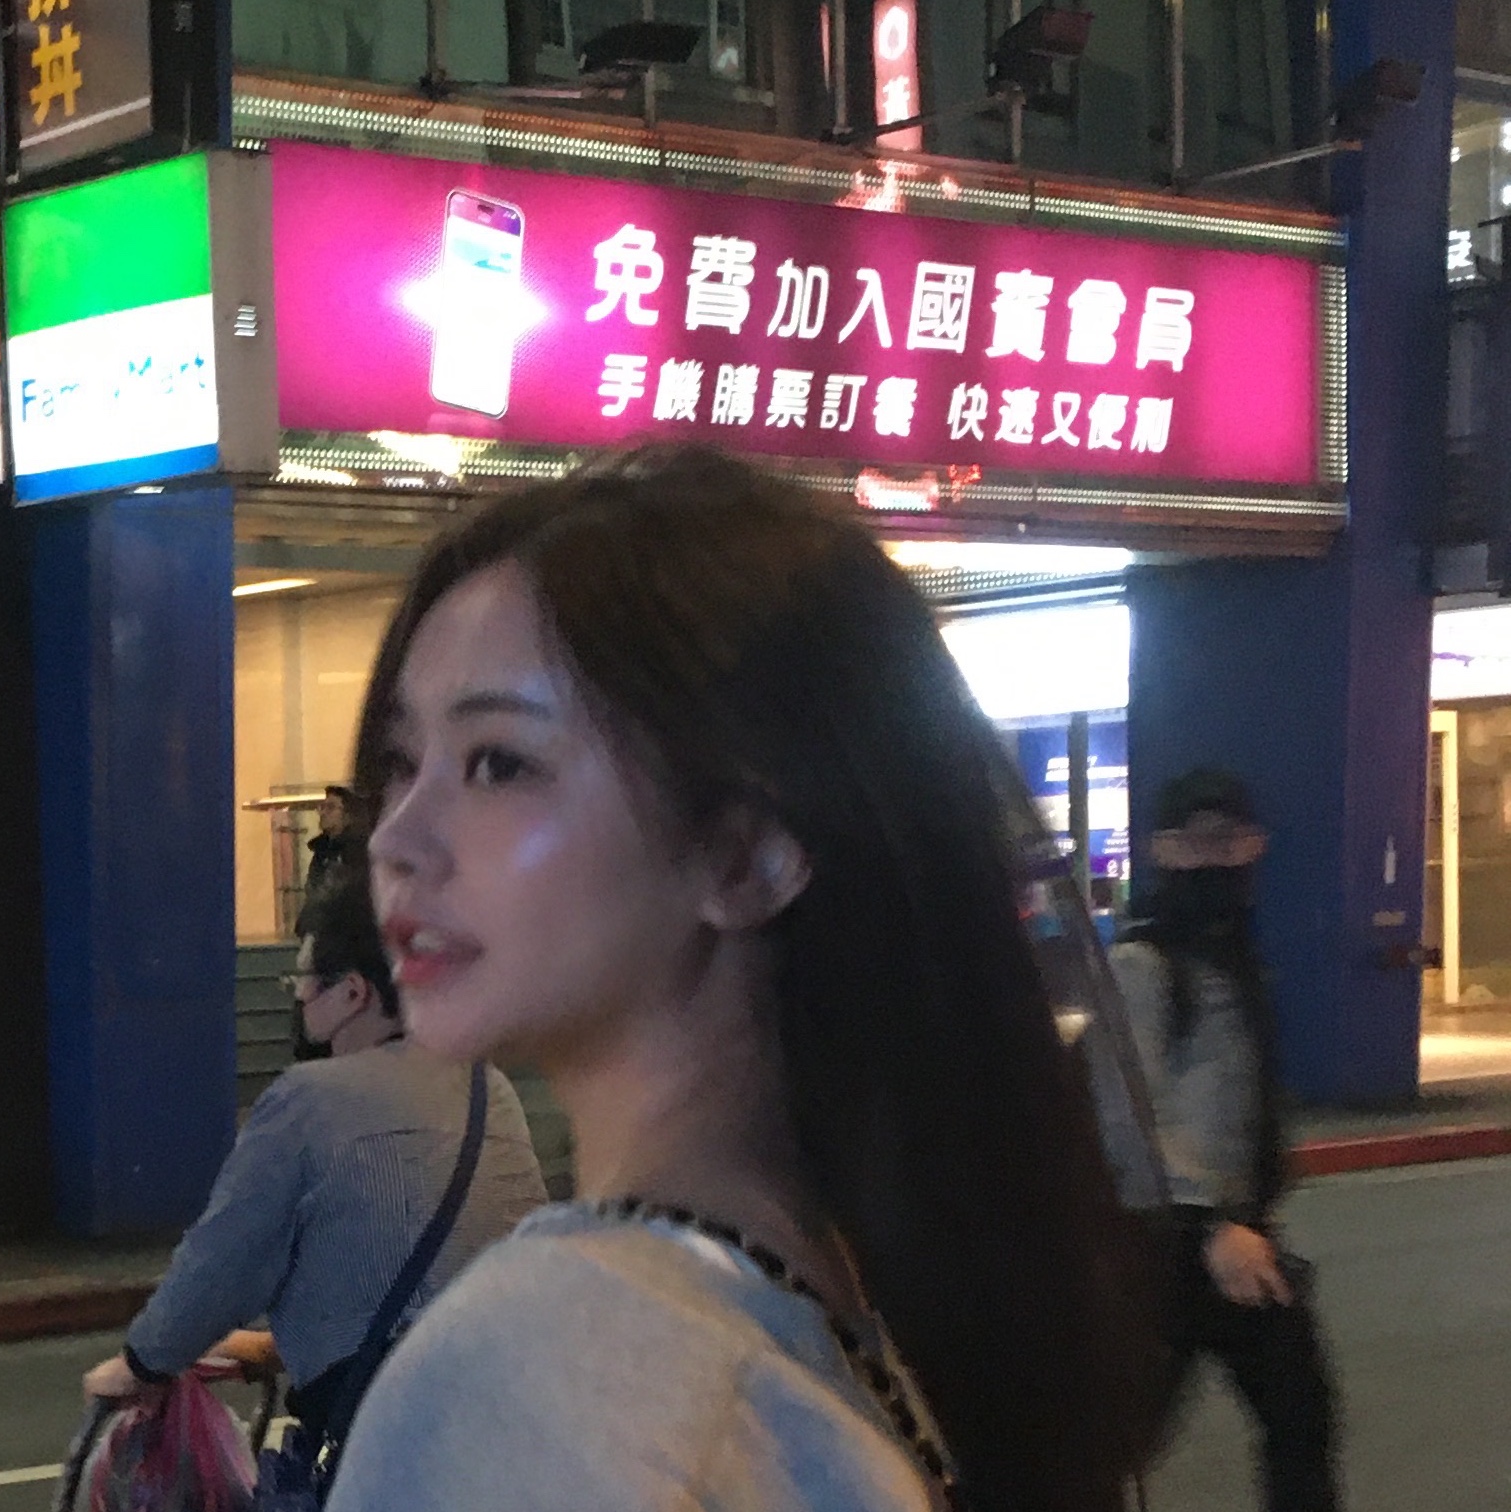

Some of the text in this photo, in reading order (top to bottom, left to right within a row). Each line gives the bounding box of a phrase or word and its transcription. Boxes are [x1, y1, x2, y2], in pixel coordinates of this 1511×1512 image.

[28, 0, 83, 127] 丼
[585, 222, 1195, 372] 免費加入國賓會員
[20, 352, 207, 424] FamMart
[596, 353, 1176, 454] 手機購票訂餐 快速又便利
